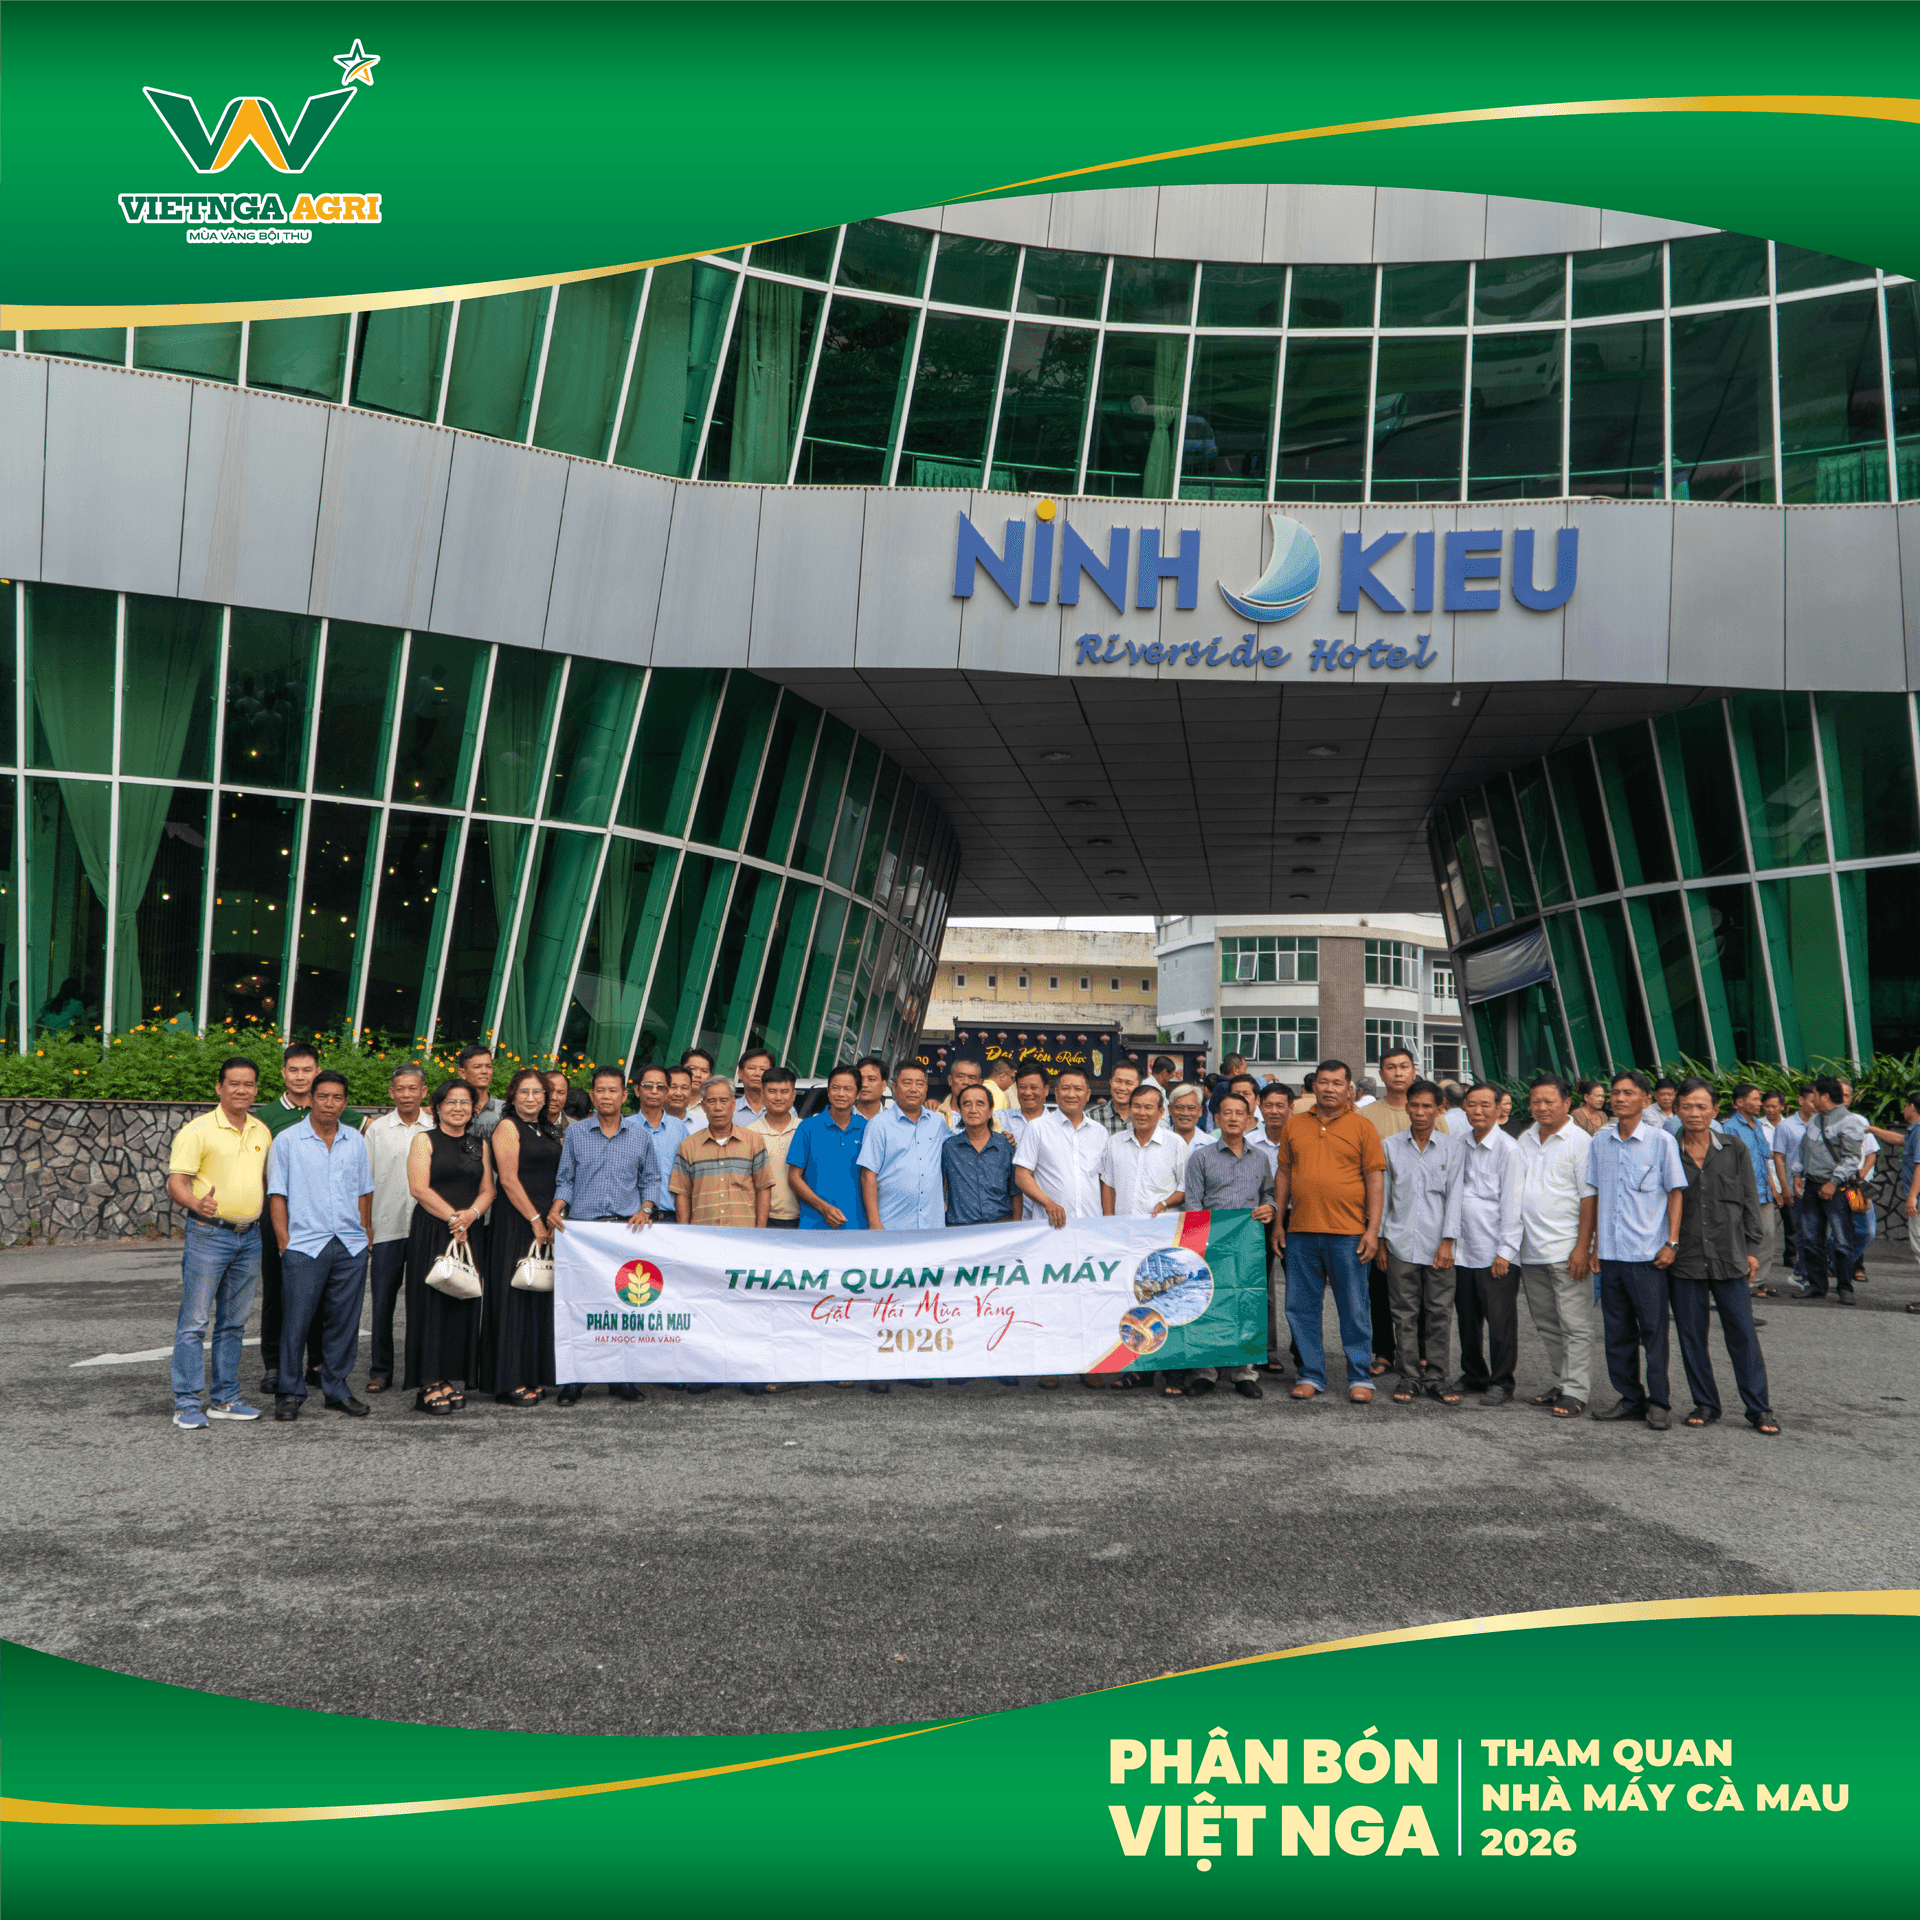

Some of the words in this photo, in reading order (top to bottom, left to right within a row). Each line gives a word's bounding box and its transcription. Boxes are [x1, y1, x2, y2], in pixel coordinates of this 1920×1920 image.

[1338, 527, 1580, 612] KIEU
[1076, 633, 1292, 668] Riverside
[1310, 634, 1438, 671] Hotel
[1055, 1050, 1087, 1066] Relax
[725, 1269, 829, 1291] THAM
[840, 1267, 945, 1294] QUAN
[953, 1258, 1030, 1287] NHÀ
[1041, 1256, 1122, 1285] MÁY
[586, 1310, 619, 1332] PHÂN
[621, 1310, 645, 1332] BÓN
[647, 1310, 664, 1332] CÀ
[666, 1313, 692, 1332] MAU
[873, 1292, 905, 1320] Hái
[914, 1289, 964, 1325] Mùa
[974, 1287, 1044, 1352] Vàng
[877, 1327, 955, 1354] 2026
